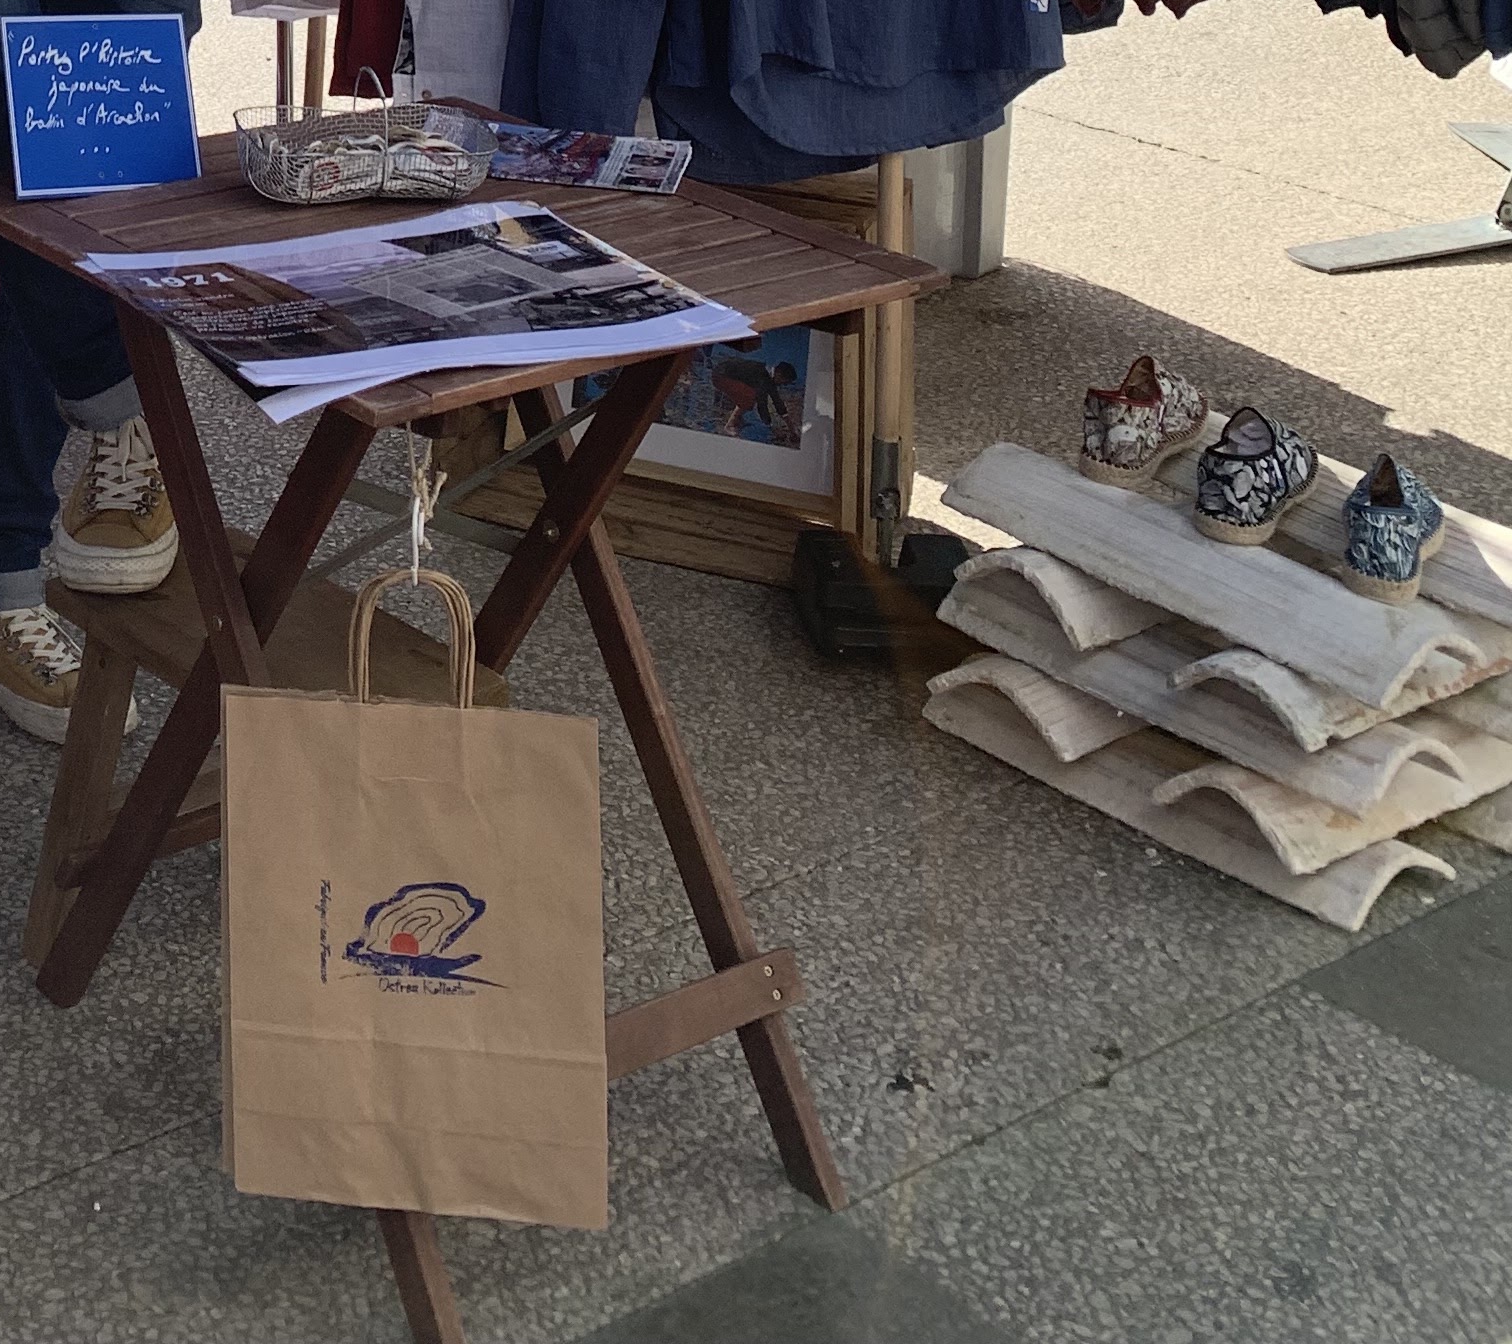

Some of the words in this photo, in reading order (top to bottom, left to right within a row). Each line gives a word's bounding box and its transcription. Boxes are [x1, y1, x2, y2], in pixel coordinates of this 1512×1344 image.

[47, 75, 131, 111] japonaise
[138, 77, 166, 94] du
[24, 106, 64, 133] bassin
[138, 271, 235, 289] 1971
[378, 977, 418, 995] Ostrea
